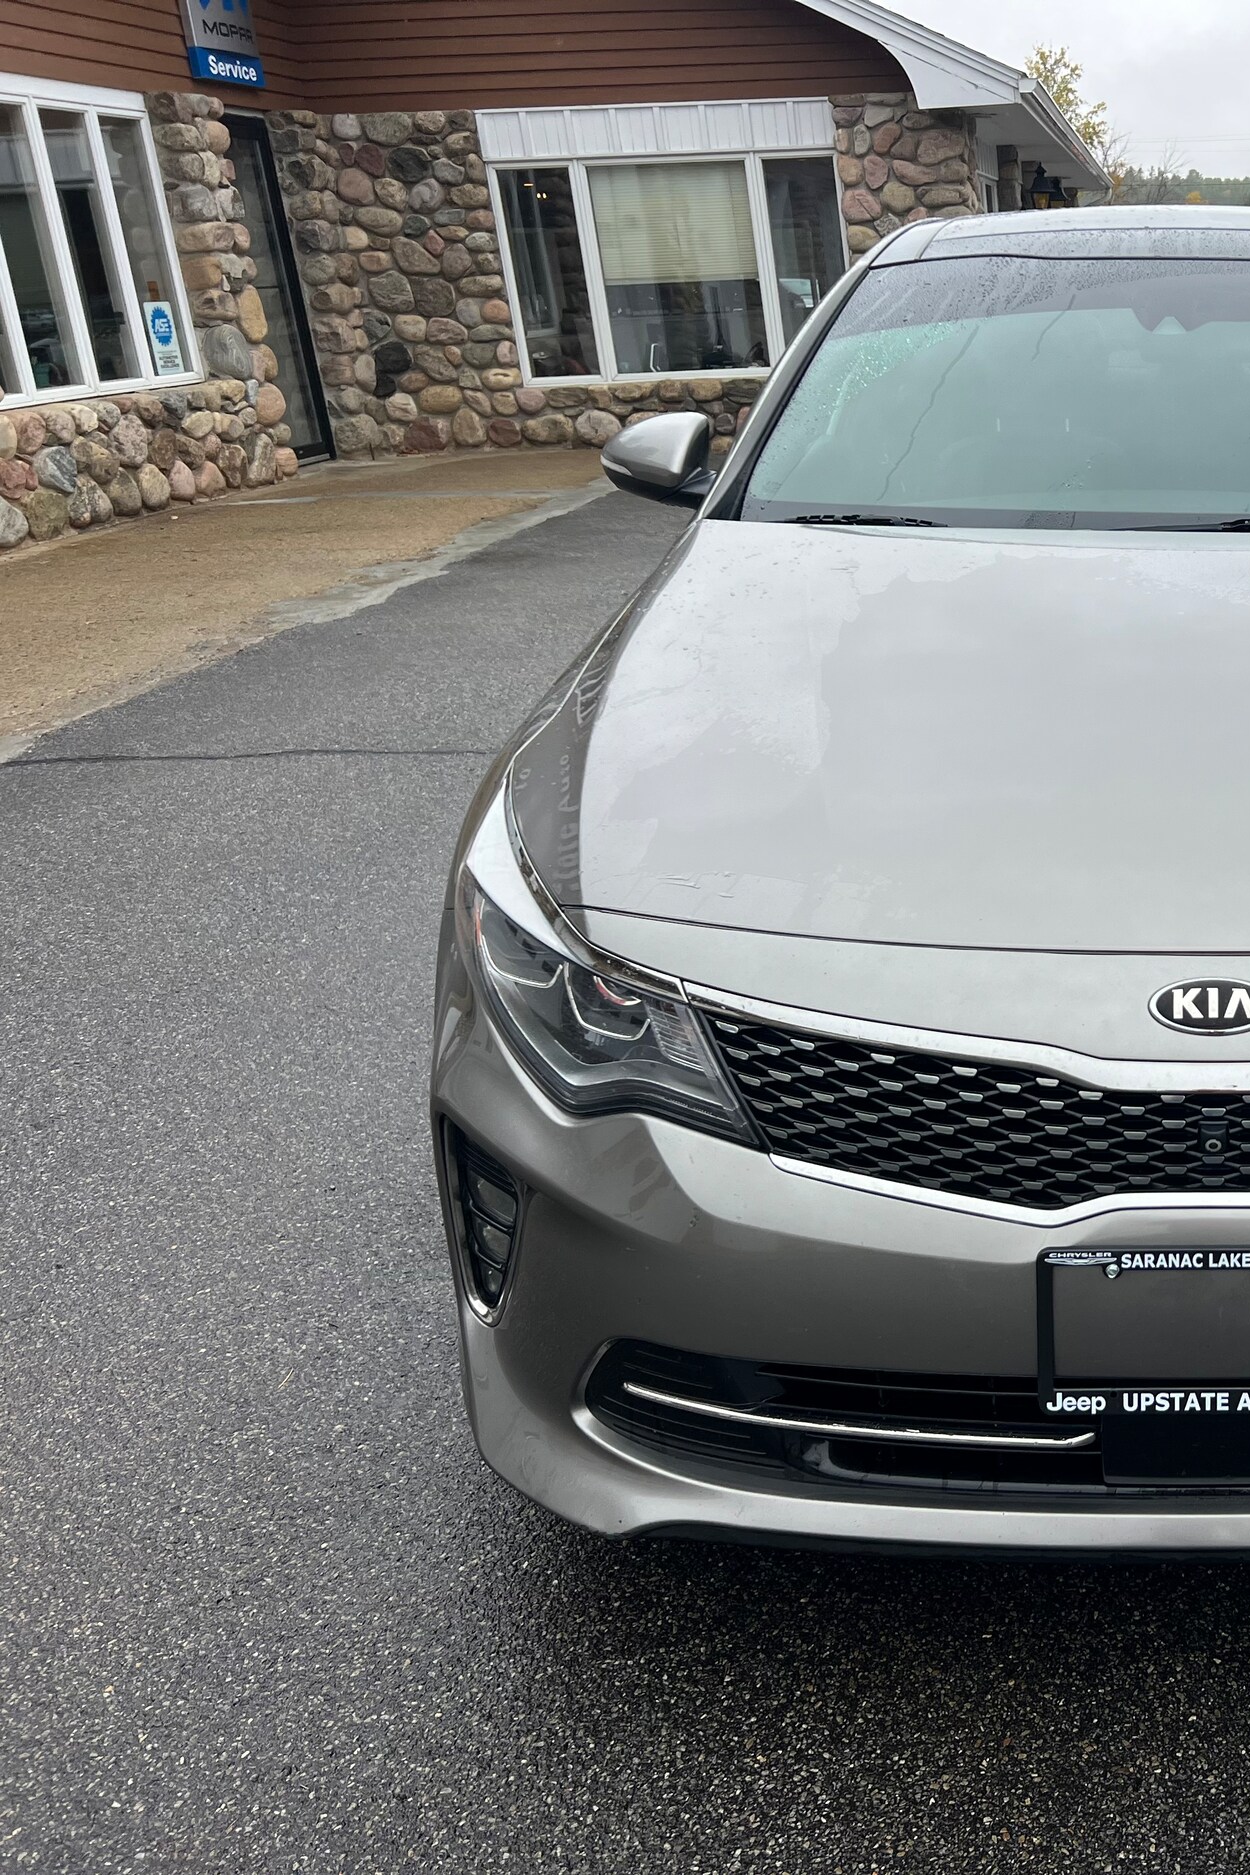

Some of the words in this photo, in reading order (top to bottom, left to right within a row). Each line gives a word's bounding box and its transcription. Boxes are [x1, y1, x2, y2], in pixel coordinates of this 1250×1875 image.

[202, 19, 254, 44] MOPAR
[208, 55, 257, 82] Service
[1121, 1253, 1204, 1269] SARANAC
[1046, 1392, 1107, 1415] Jeep
[1122, 1392, 1230, 1412] UPSTATE
